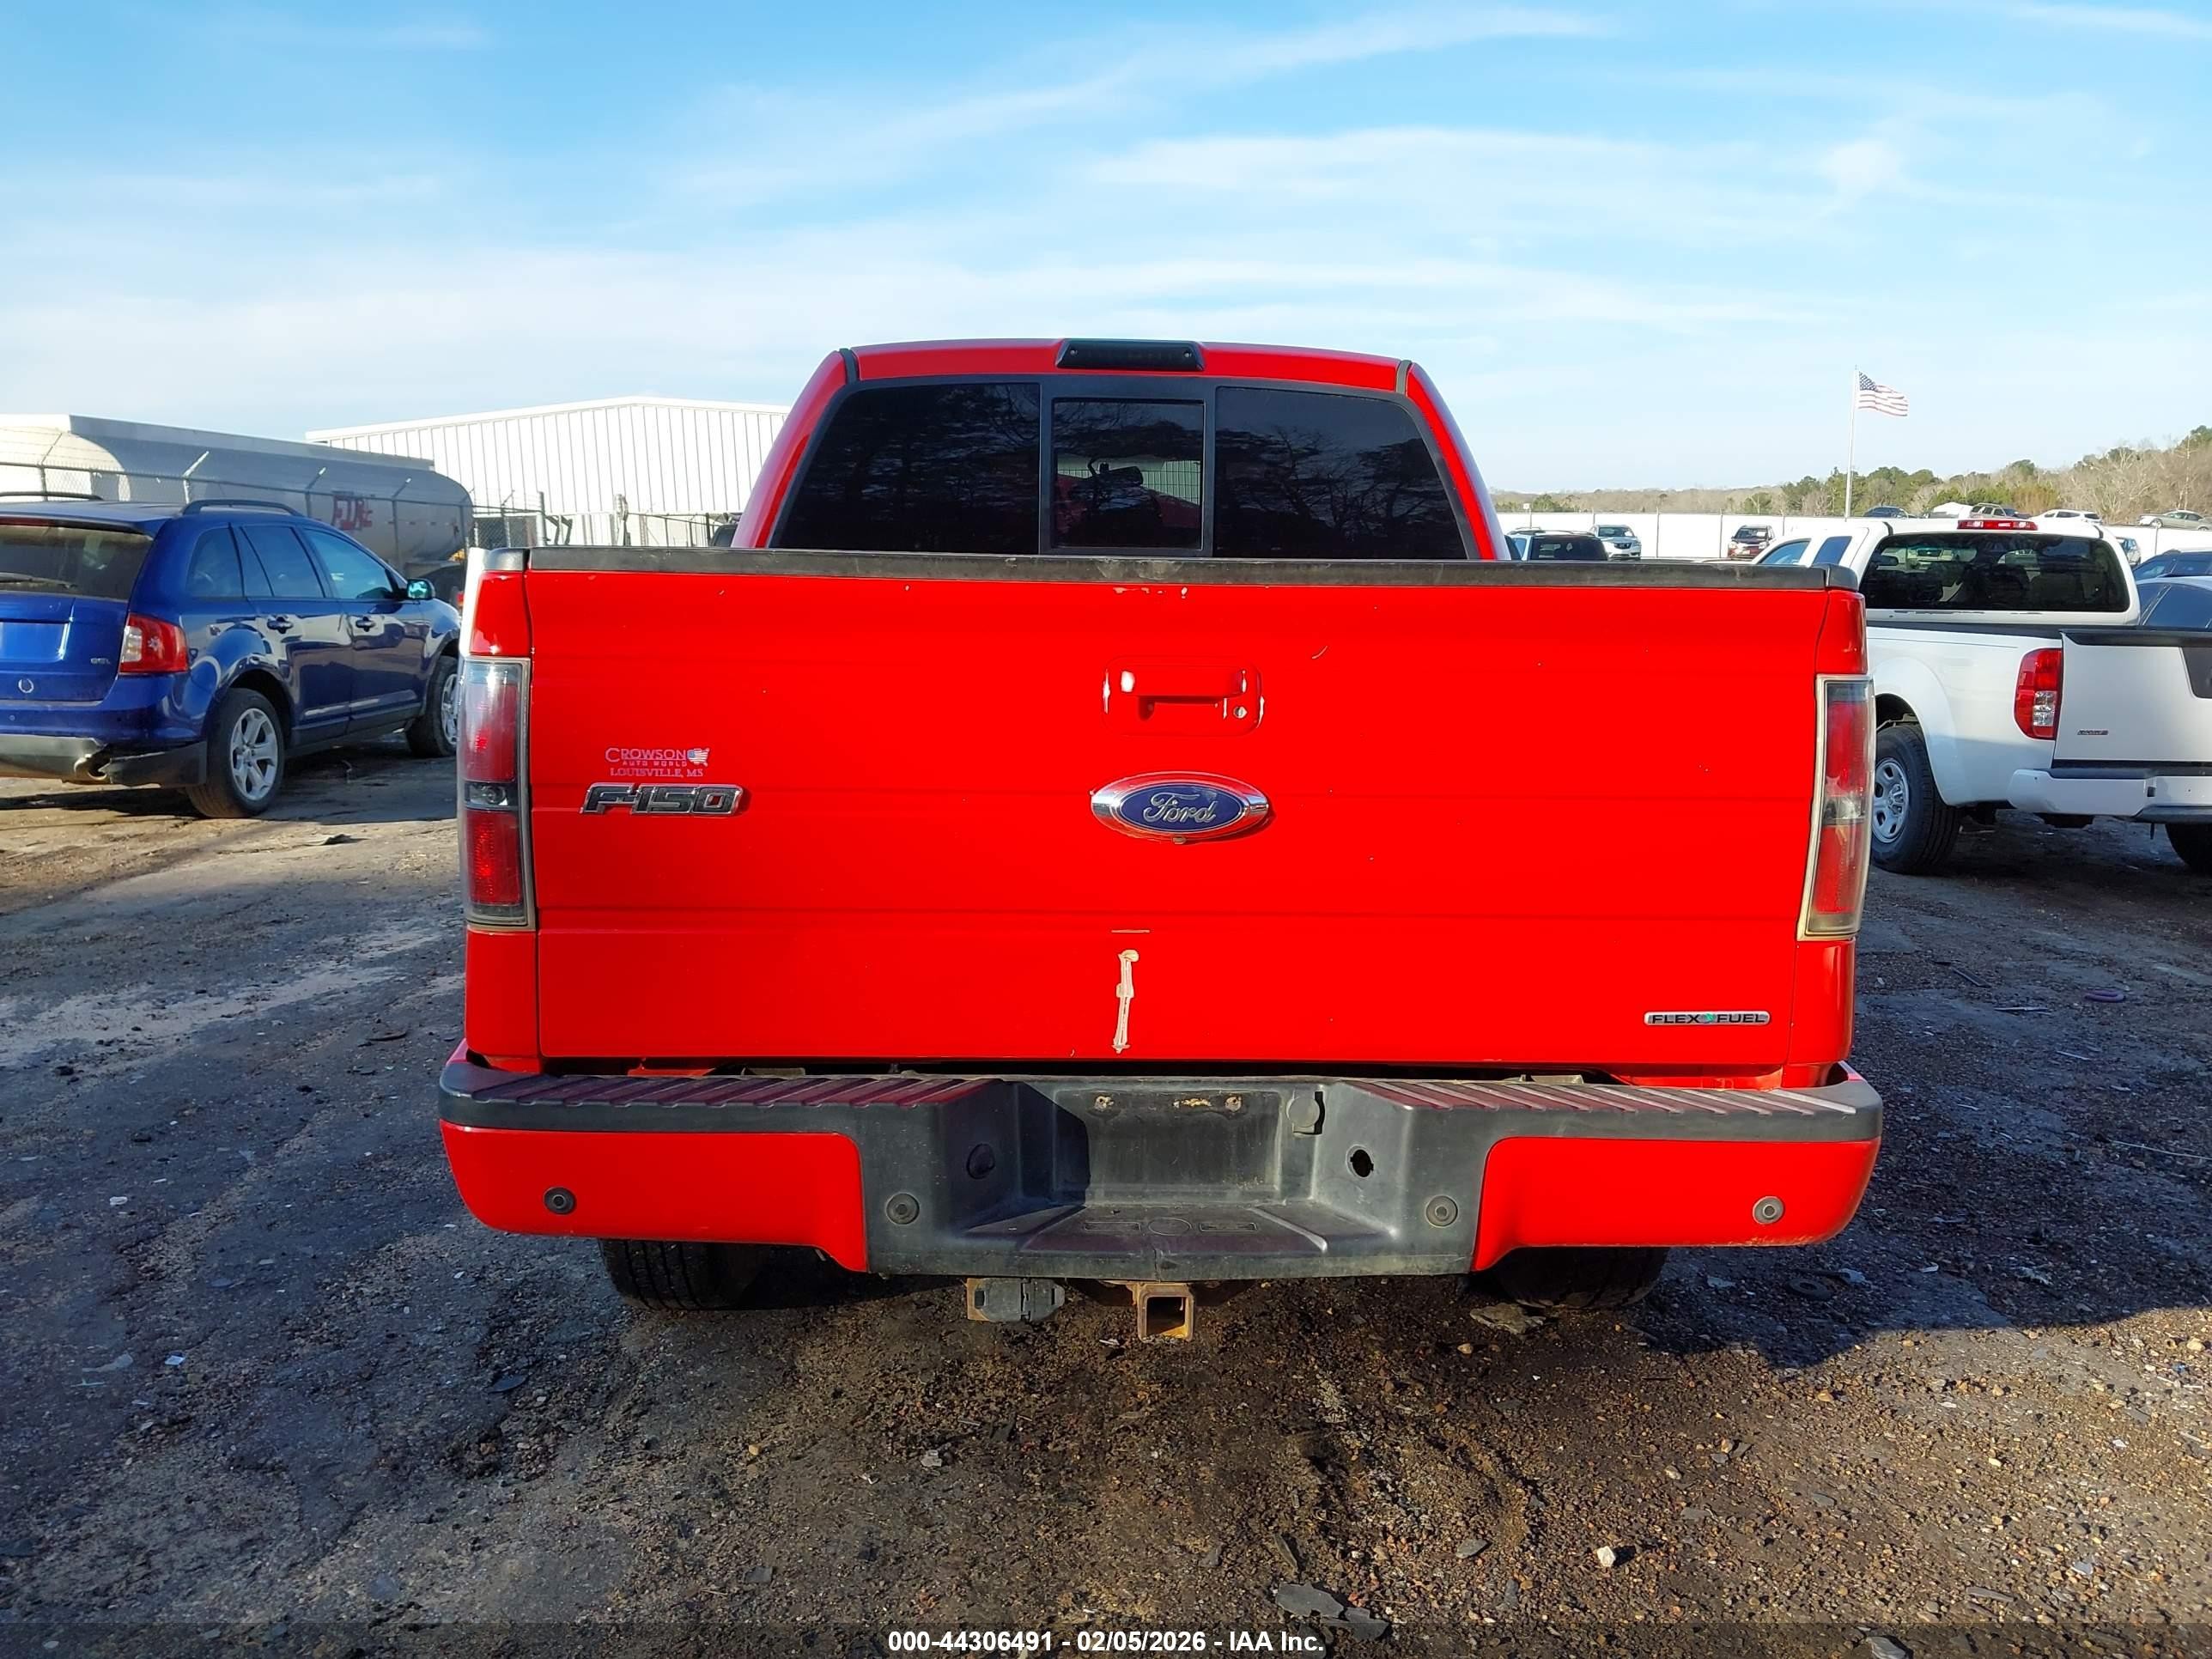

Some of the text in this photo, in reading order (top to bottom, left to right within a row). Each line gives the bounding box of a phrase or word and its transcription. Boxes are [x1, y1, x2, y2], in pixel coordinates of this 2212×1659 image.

[605, 747, 687, 763] CROWSON
[610, 768, 704, 778] LOUISVILLE, MS
[1143, 792, 1218, 823] Ford
[1651, 1013, 1766, 1024] FLEX FUEL
